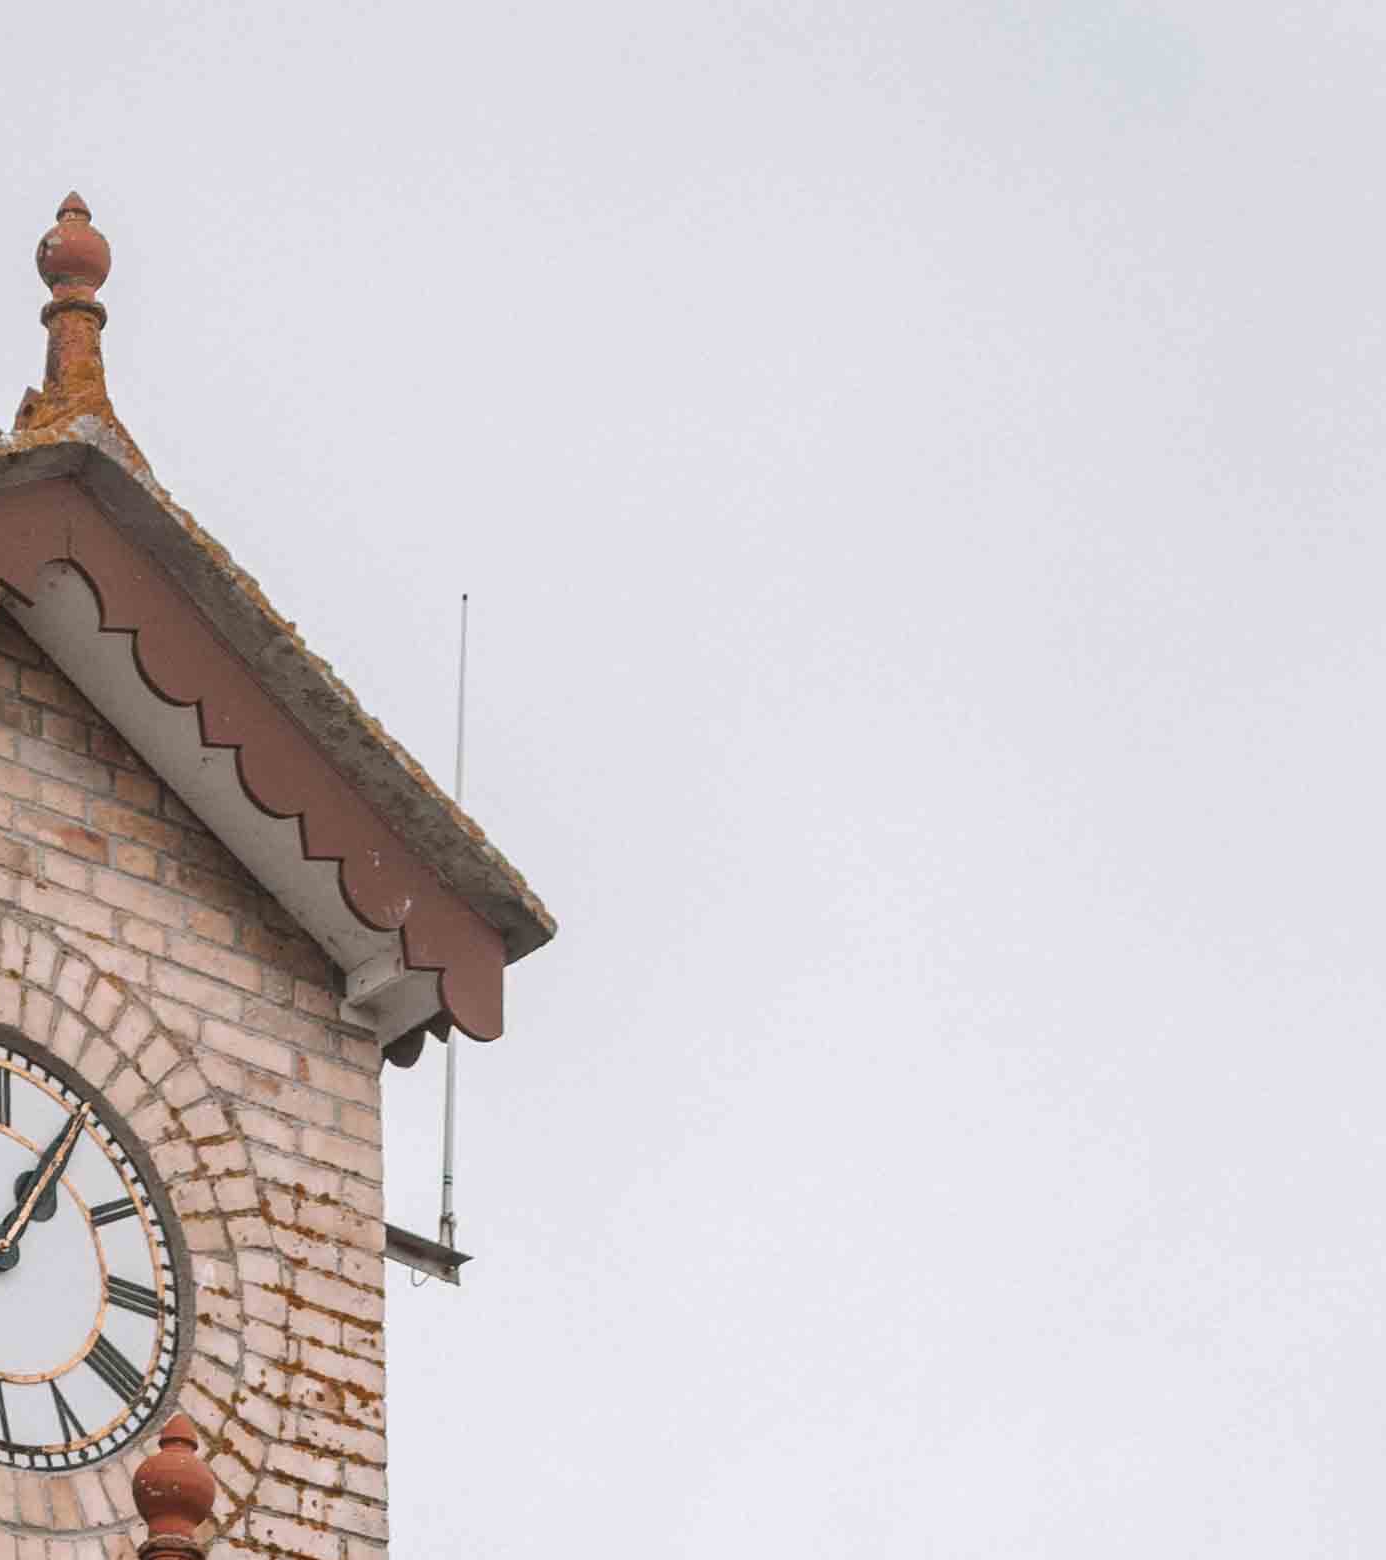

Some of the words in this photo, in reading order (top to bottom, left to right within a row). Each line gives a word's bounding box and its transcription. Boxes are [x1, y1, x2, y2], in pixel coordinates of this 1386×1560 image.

[89, 1196, 141, 1228] II
[106, 1275, 159, 1319] III
[49, 1379, 89, 1444] V
